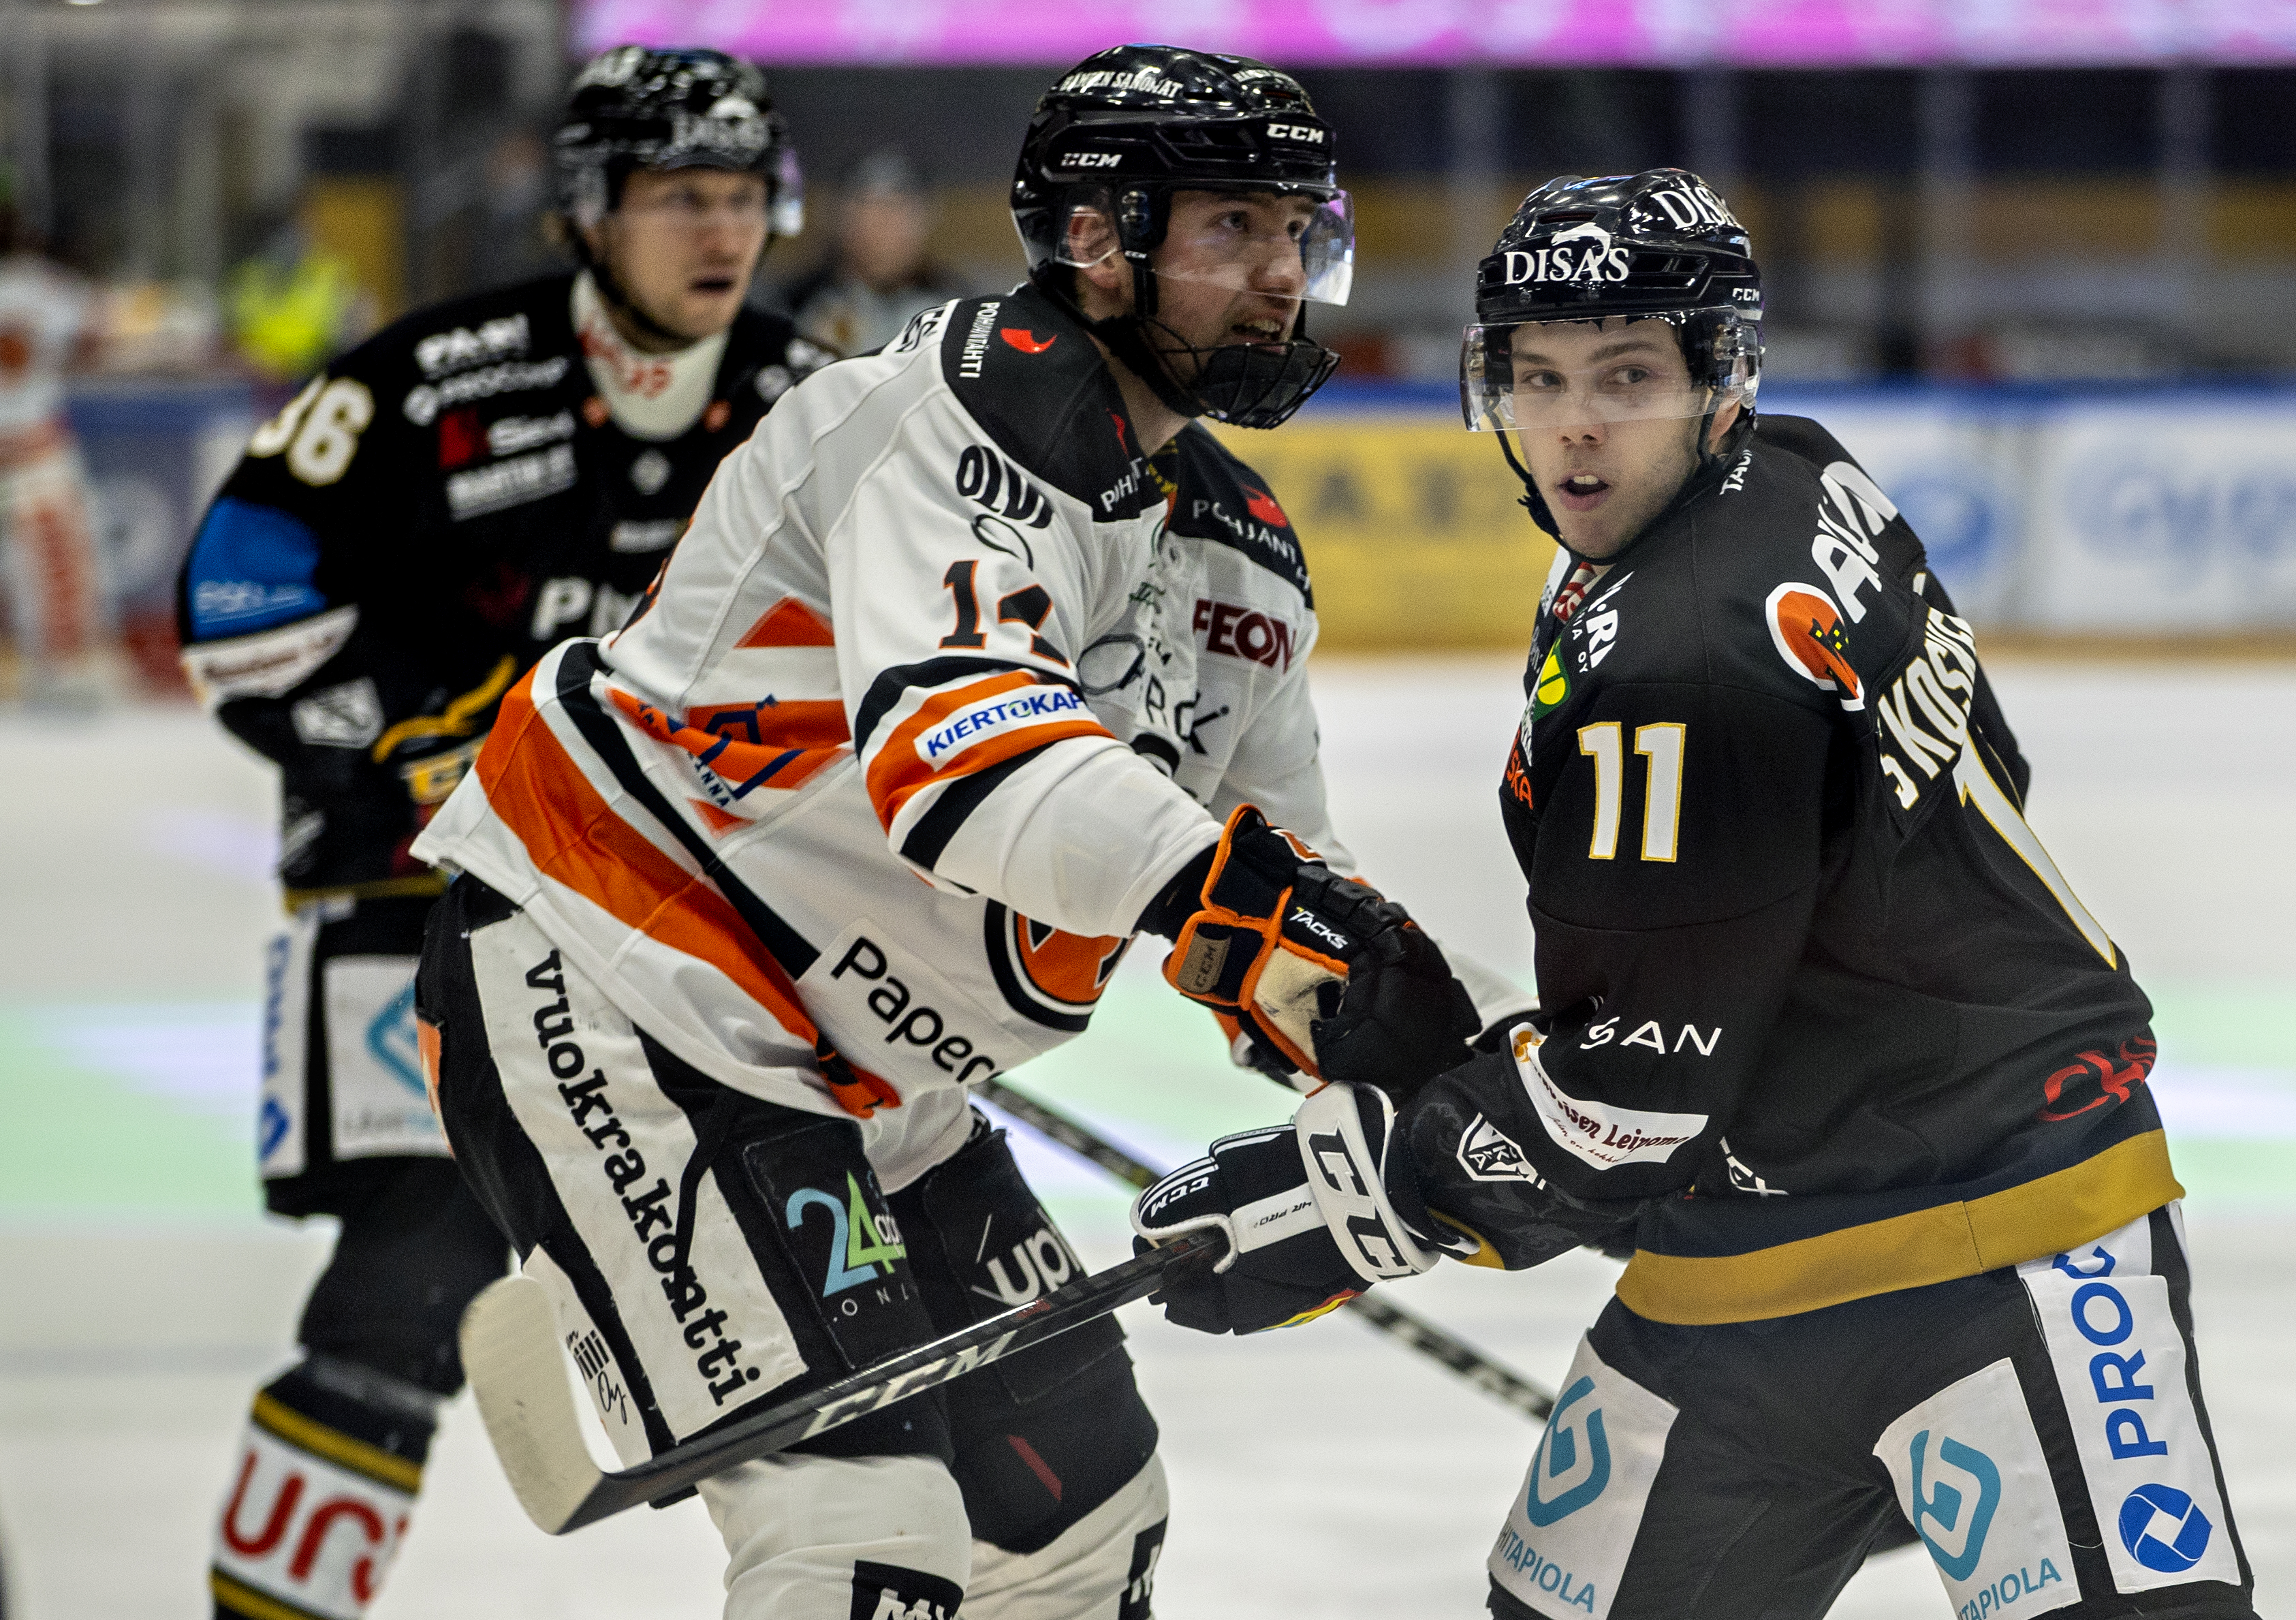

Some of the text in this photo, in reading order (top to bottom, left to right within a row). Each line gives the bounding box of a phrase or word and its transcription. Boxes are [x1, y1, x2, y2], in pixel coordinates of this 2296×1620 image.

[1266, 123, 1323, 144] CCM
[1060, 152, 1122, 168] CCM
[1504, 247, 1630, 285] DISAS
[1732, 287, 1760, 302] CCM
[1577, 721, 1687, 863] 11
[1289, 907, 1349, 950] TACKS
[830, 935, 1005, 1082] Paper
[525, 949, 761, 1406] vuokrakontti
[1151, 1176, 1210, 1219] CCM
[786, 1169, 907, 1298] 24
